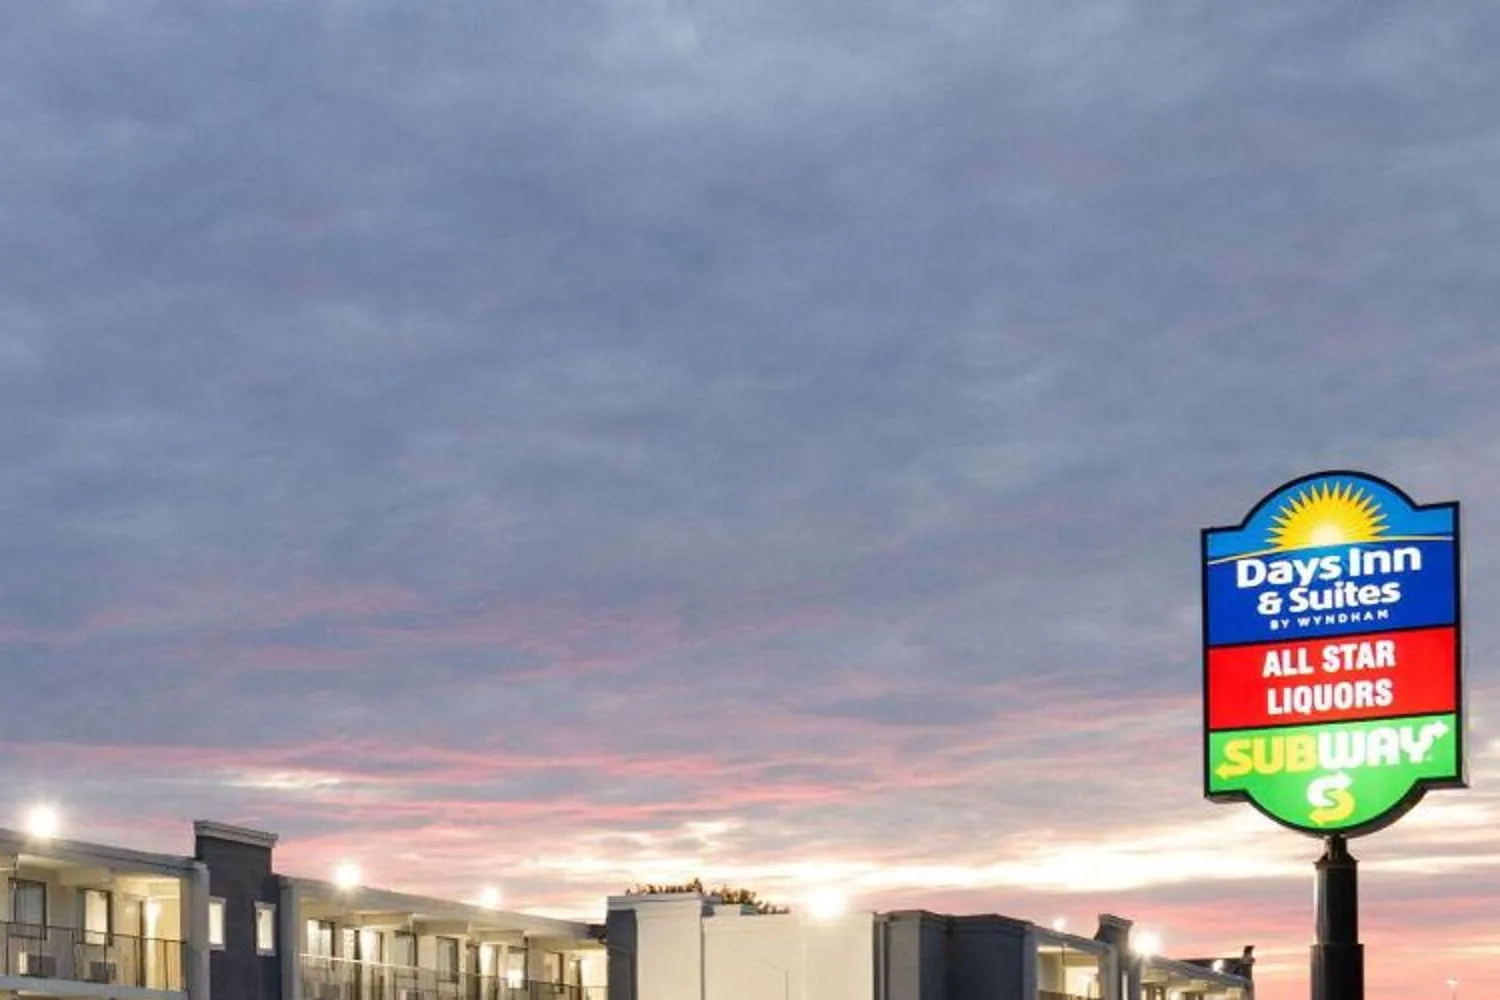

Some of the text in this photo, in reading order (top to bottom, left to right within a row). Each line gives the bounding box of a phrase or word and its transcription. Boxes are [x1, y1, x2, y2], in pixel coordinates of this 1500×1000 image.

[1236, 546, 1422, 588] Days Inn
[1257, 581, 1402, 615] & Suites
[1269, 609, 1389, 631] BY WYNDHAM
[1262, 640, 1396, 678] ALL STAR
[1267, 678, 1394, 715] LIQUORS
[1215, 719, 1450, 780] SUBWAY
